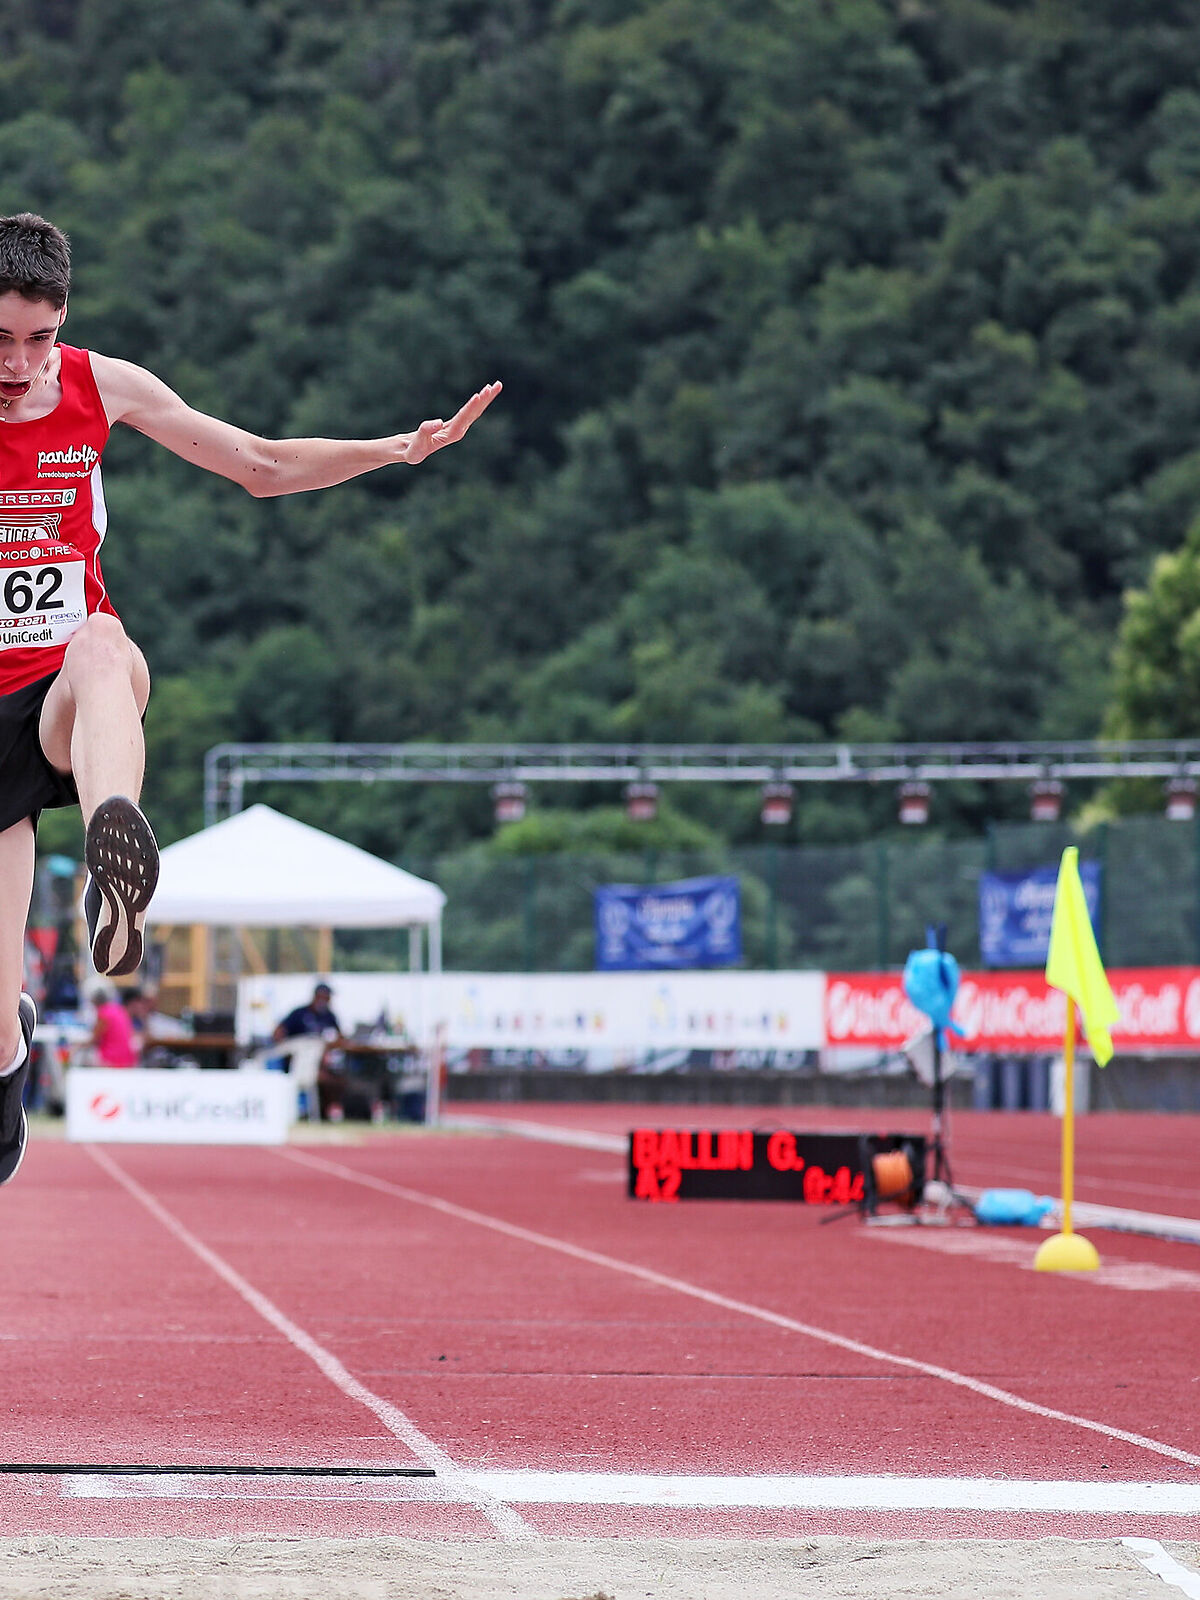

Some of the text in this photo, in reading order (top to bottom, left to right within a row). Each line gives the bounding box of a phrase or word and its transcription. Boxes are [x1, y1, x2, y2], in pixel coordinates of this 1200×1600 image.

[37, 443, 99, 470] pandolfo
[16, 615, 45, 626] 2021
[2, 628, 54, 645] UniCredit
